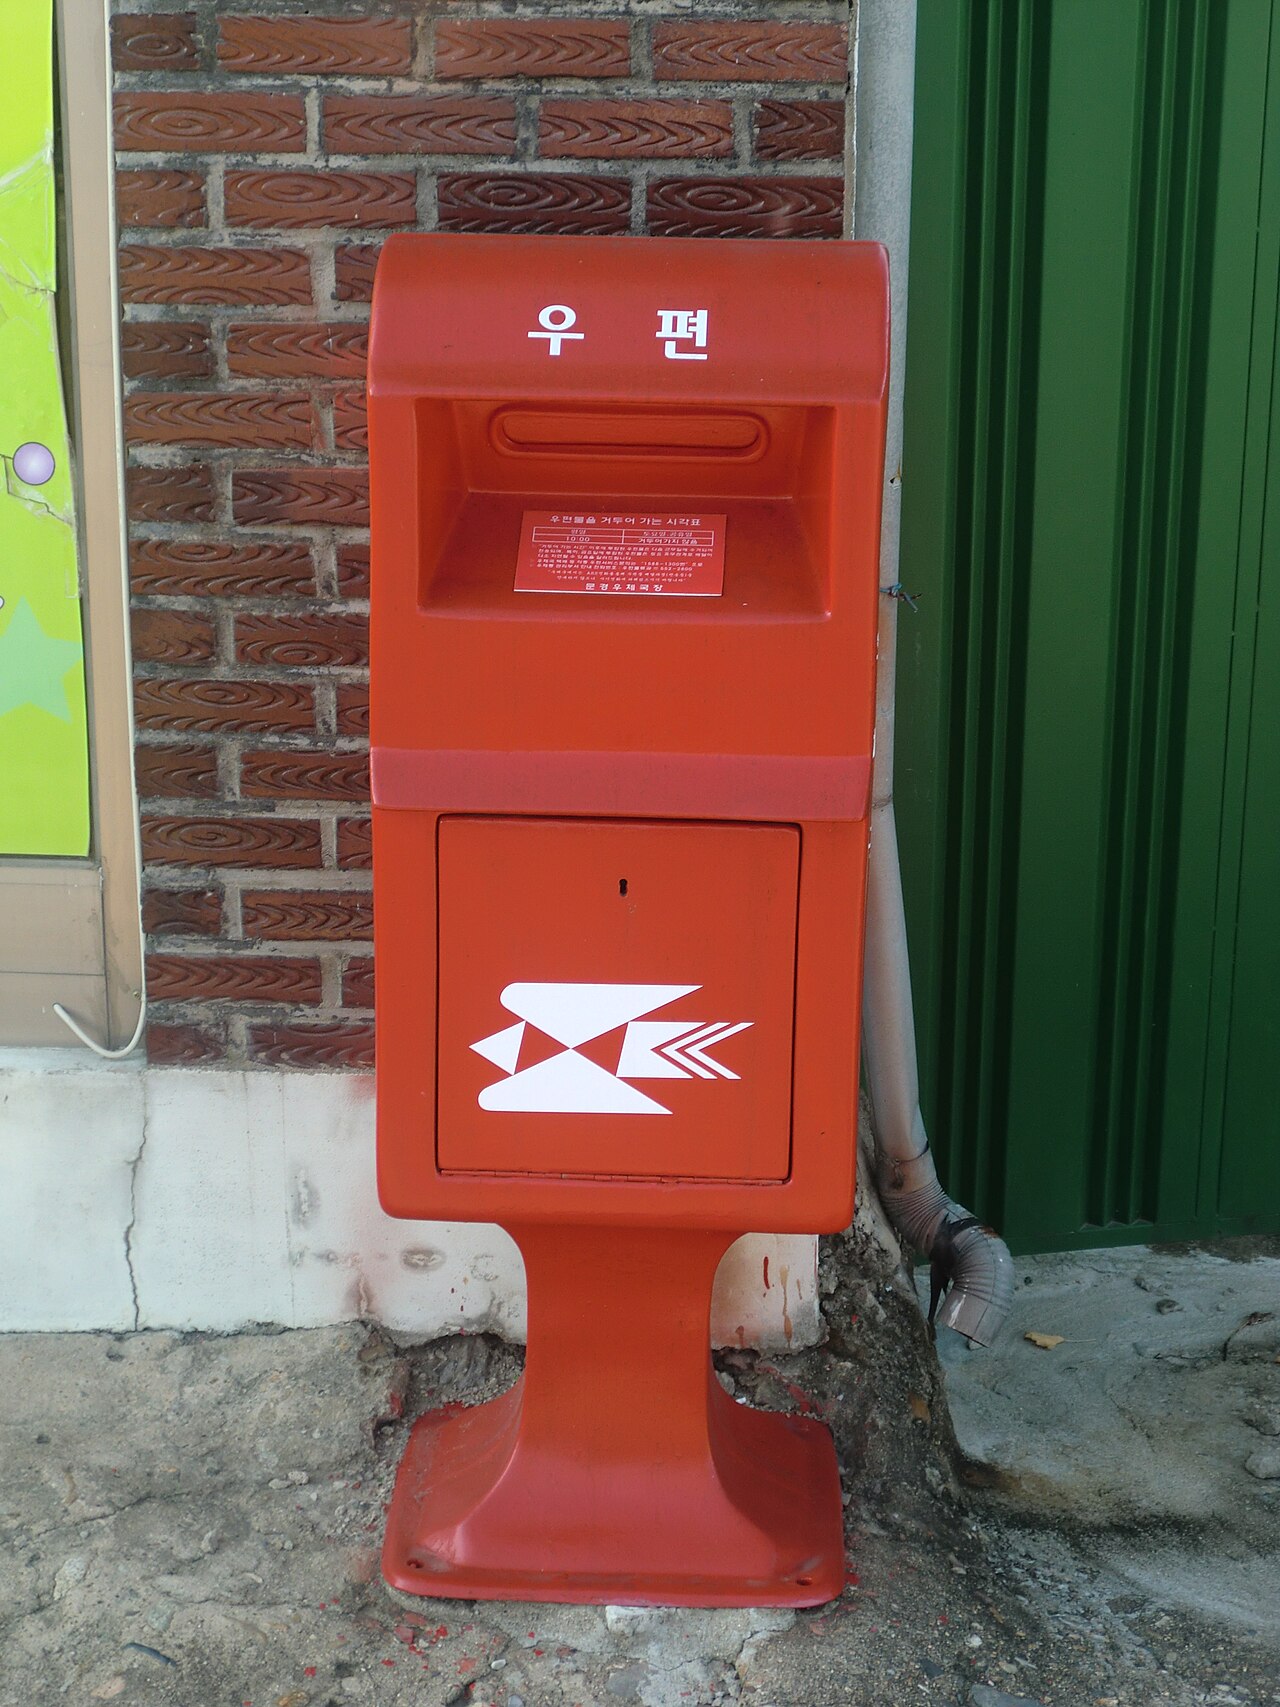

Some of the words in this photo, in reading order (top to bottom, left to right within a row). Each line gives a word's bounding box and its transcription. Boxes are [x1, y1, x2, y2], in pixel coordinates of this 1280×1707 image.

[527, 304, 708, 360] 우편
[550, 515, 596, 523] 우편물을
[601, 516, 635, 524] 거두어
[639, 517, 662, 525] 가는
[585, 582, 663, 591] 문경우체국장
